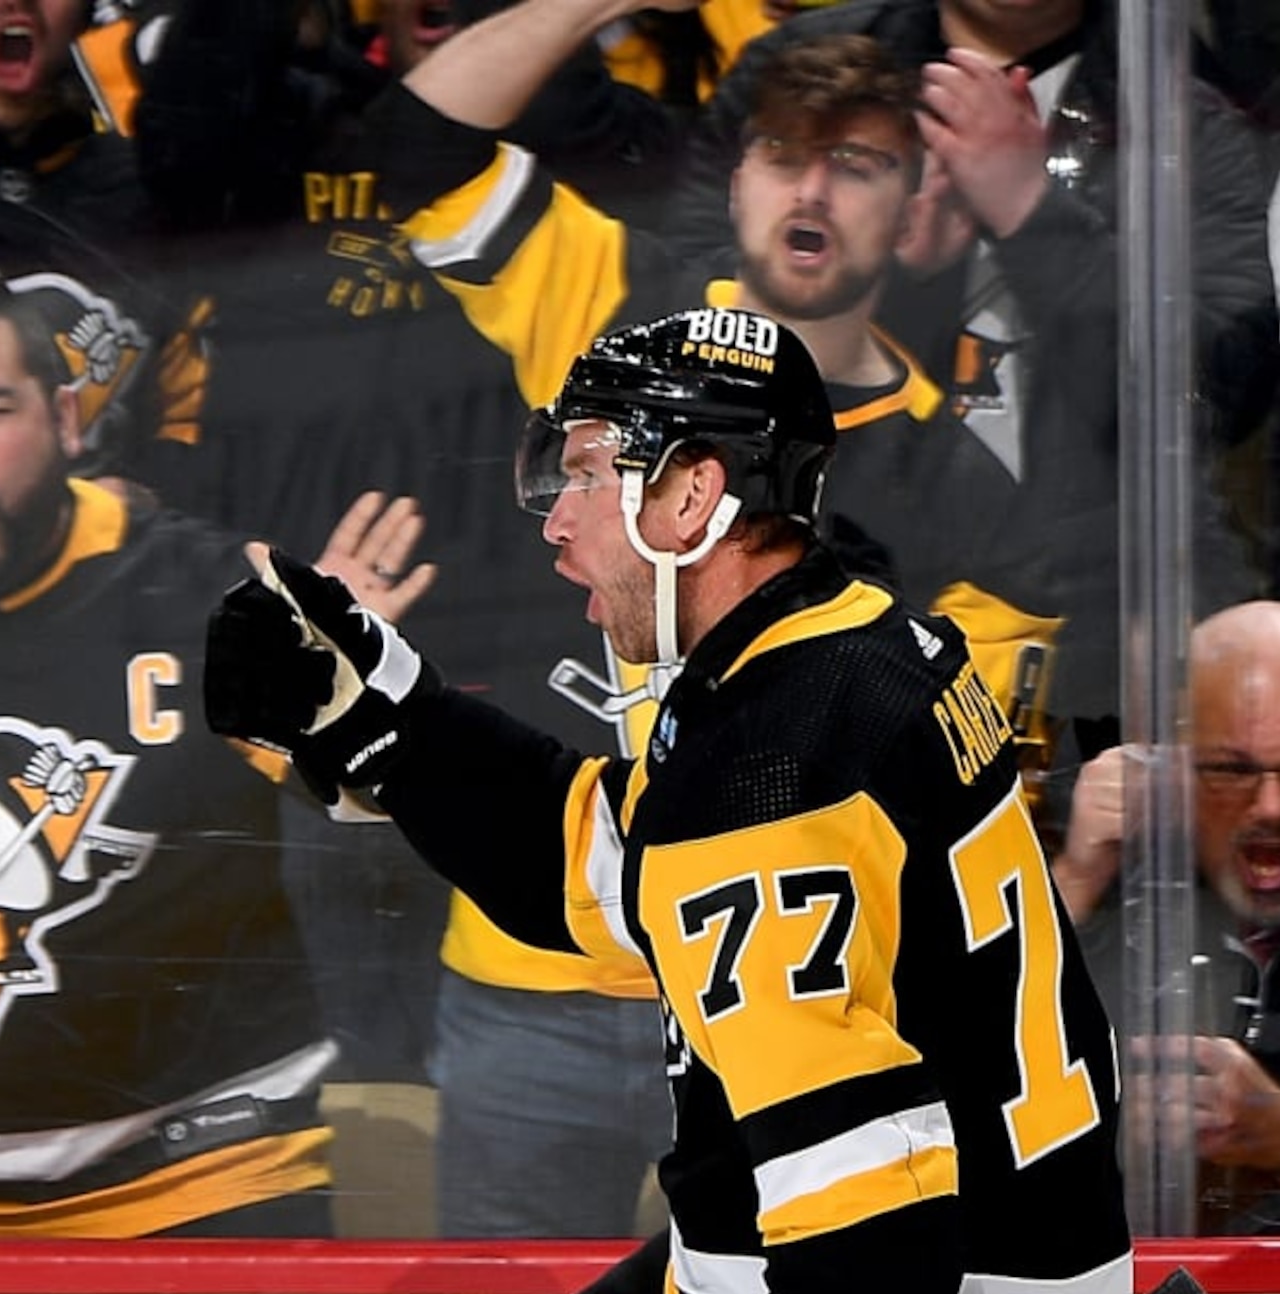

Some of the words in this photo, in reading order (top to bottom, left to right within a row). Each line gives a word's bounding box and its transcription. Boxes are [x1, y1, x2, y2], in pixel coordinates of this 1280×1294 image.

[681, 341, 775, 375] PENGUIN
[686, 307, 778, 357] BOLD
[126, 652, 184, 745] C
[933, 660, 1014, 786] CARTE
[675, 865, 860, 1025] 77
[948, 773, 1122, 1170] 7
